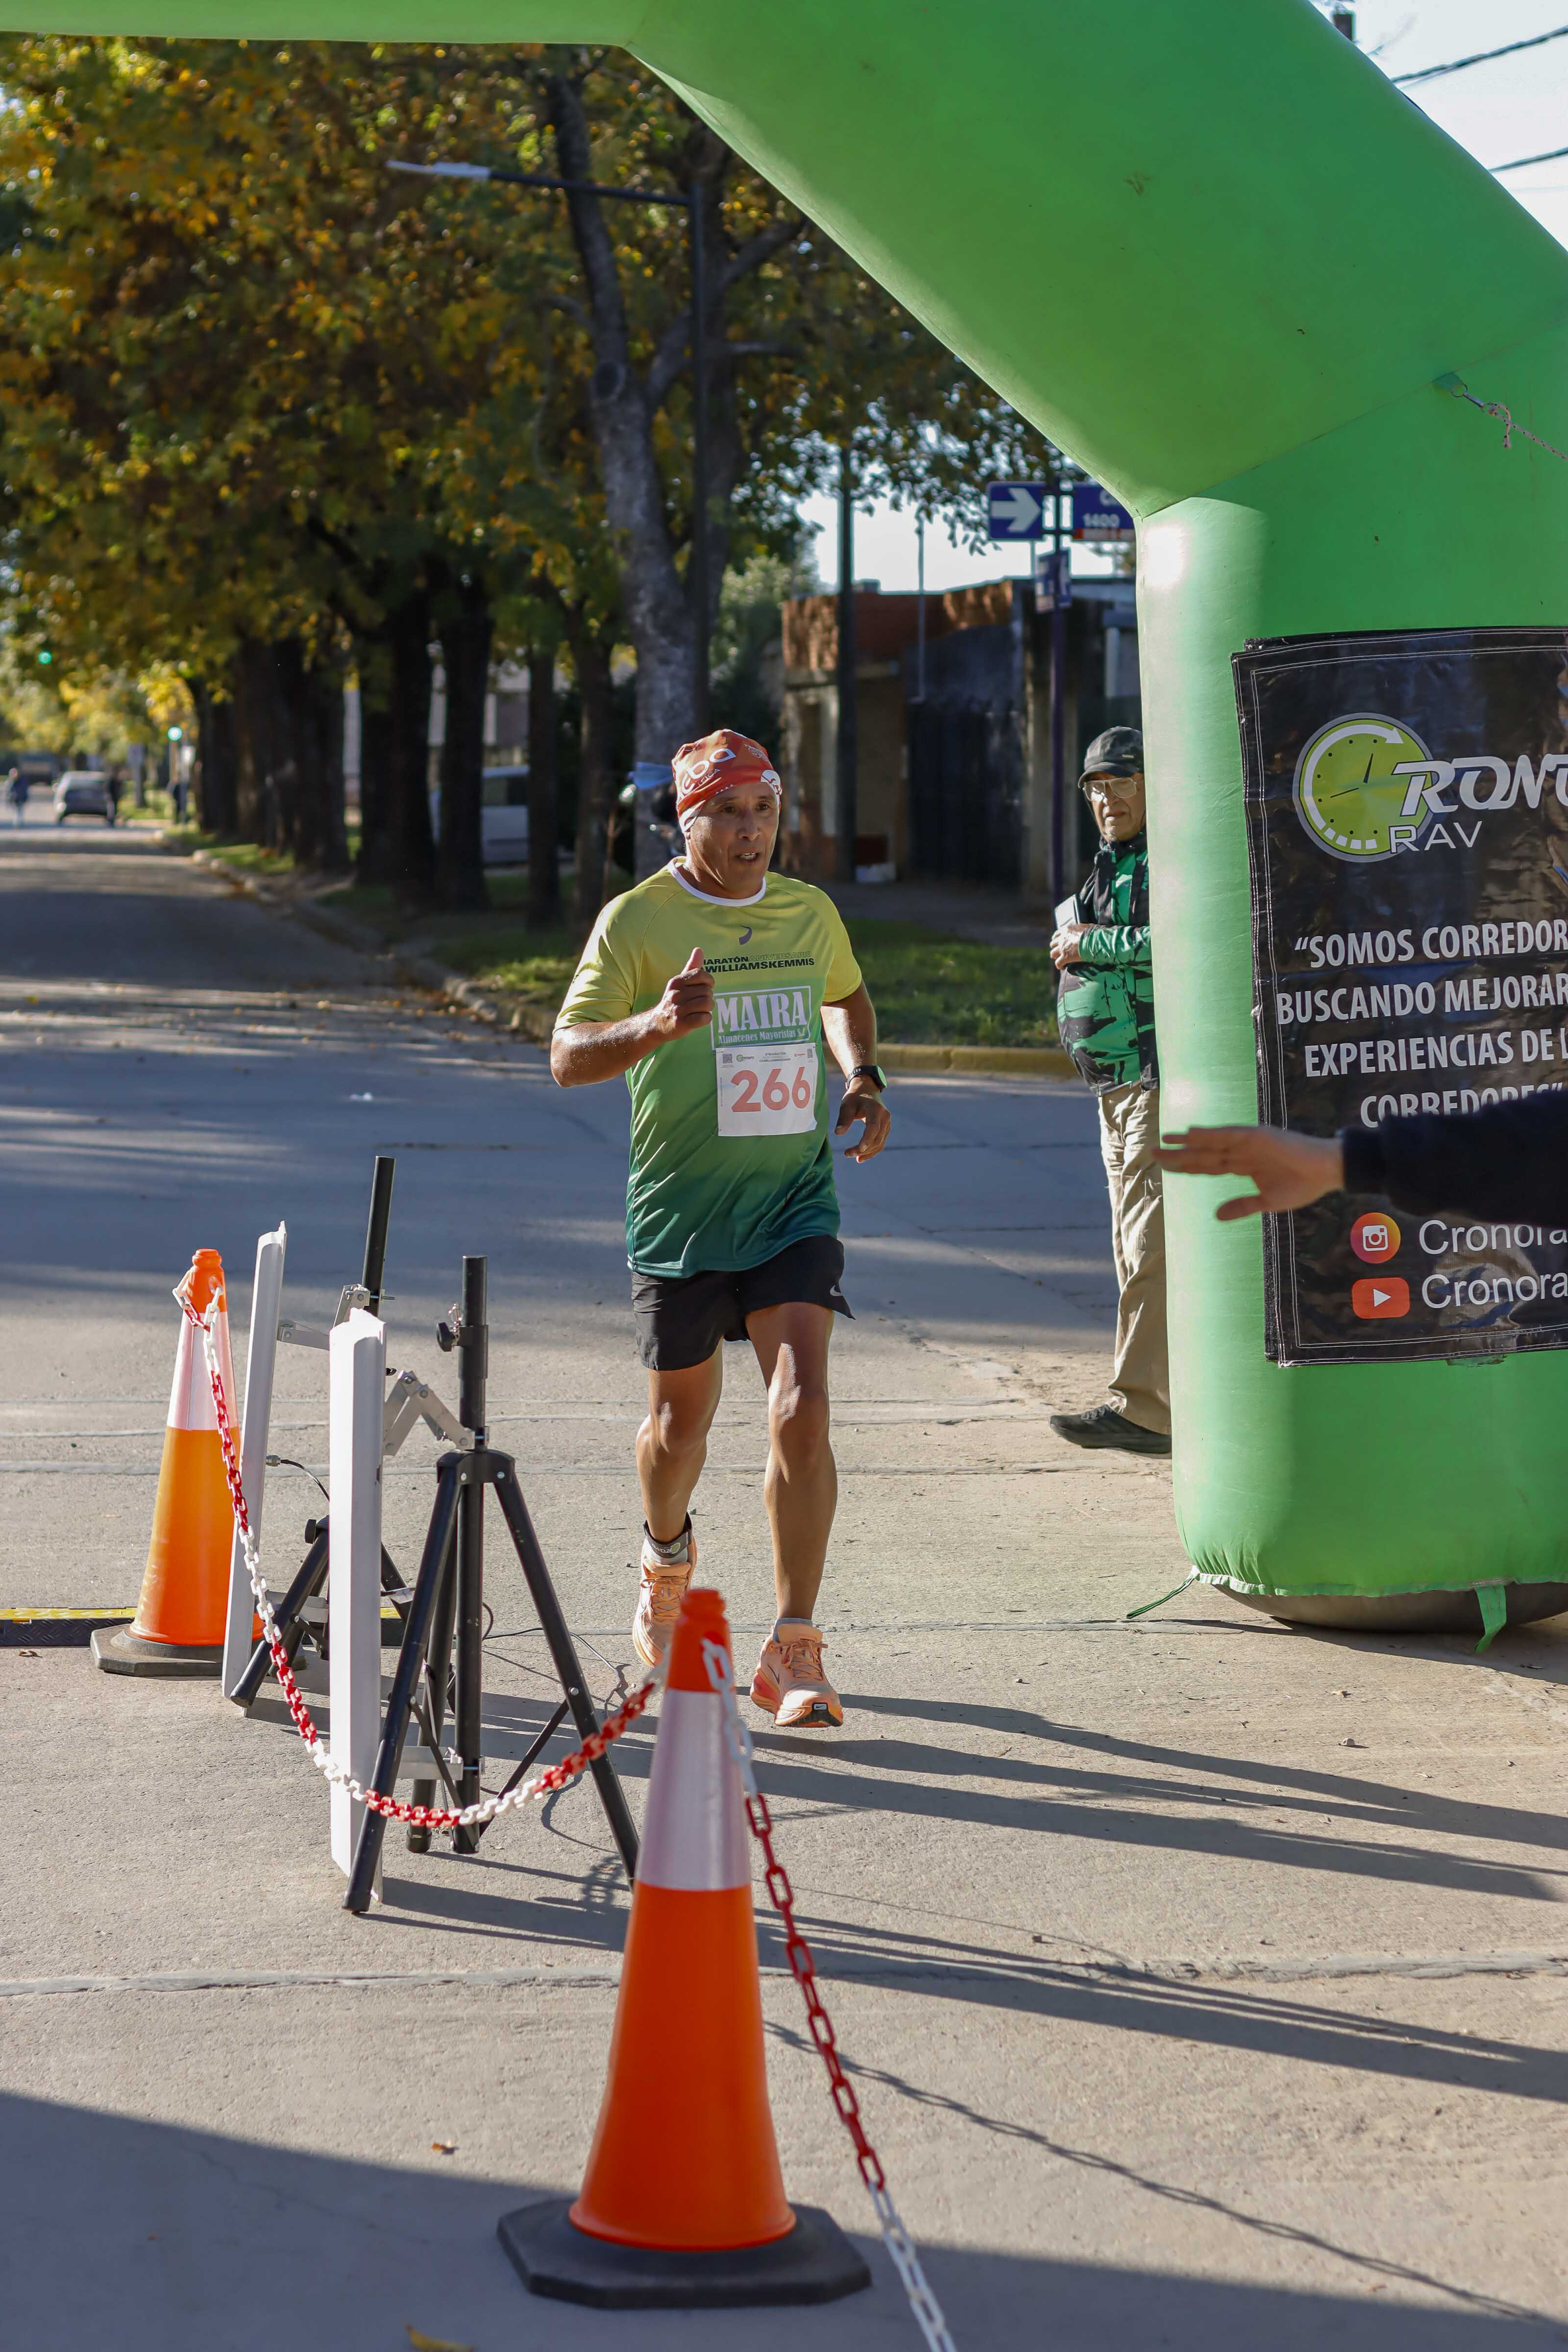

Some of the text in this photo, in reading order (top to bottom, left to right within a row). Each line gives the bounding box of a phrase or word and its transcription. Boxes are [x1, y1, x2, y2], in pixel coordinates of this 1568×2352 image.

[1389, 821, 1483, 854] RAV
[1422, 918, 1568, 959] CORREDOR
[703, 956, 748, 965] ARATÓN
[716, 991, 807, 1033] MAIRA
[1277, 973, 1568, 1024] BUSCANDO MEJORAR
[718, 1033, 758, 1045] Almacenes
[760, 1029, 796, 1041] Mayoristas
[1304, 1031, 1514, 1077] EXPERIENCIAS
[1521, 1029, 1554, 1062] DE
[730, 1066, 811, 1113] 266
[1422, 1272, 1568, 1309] Cronora
